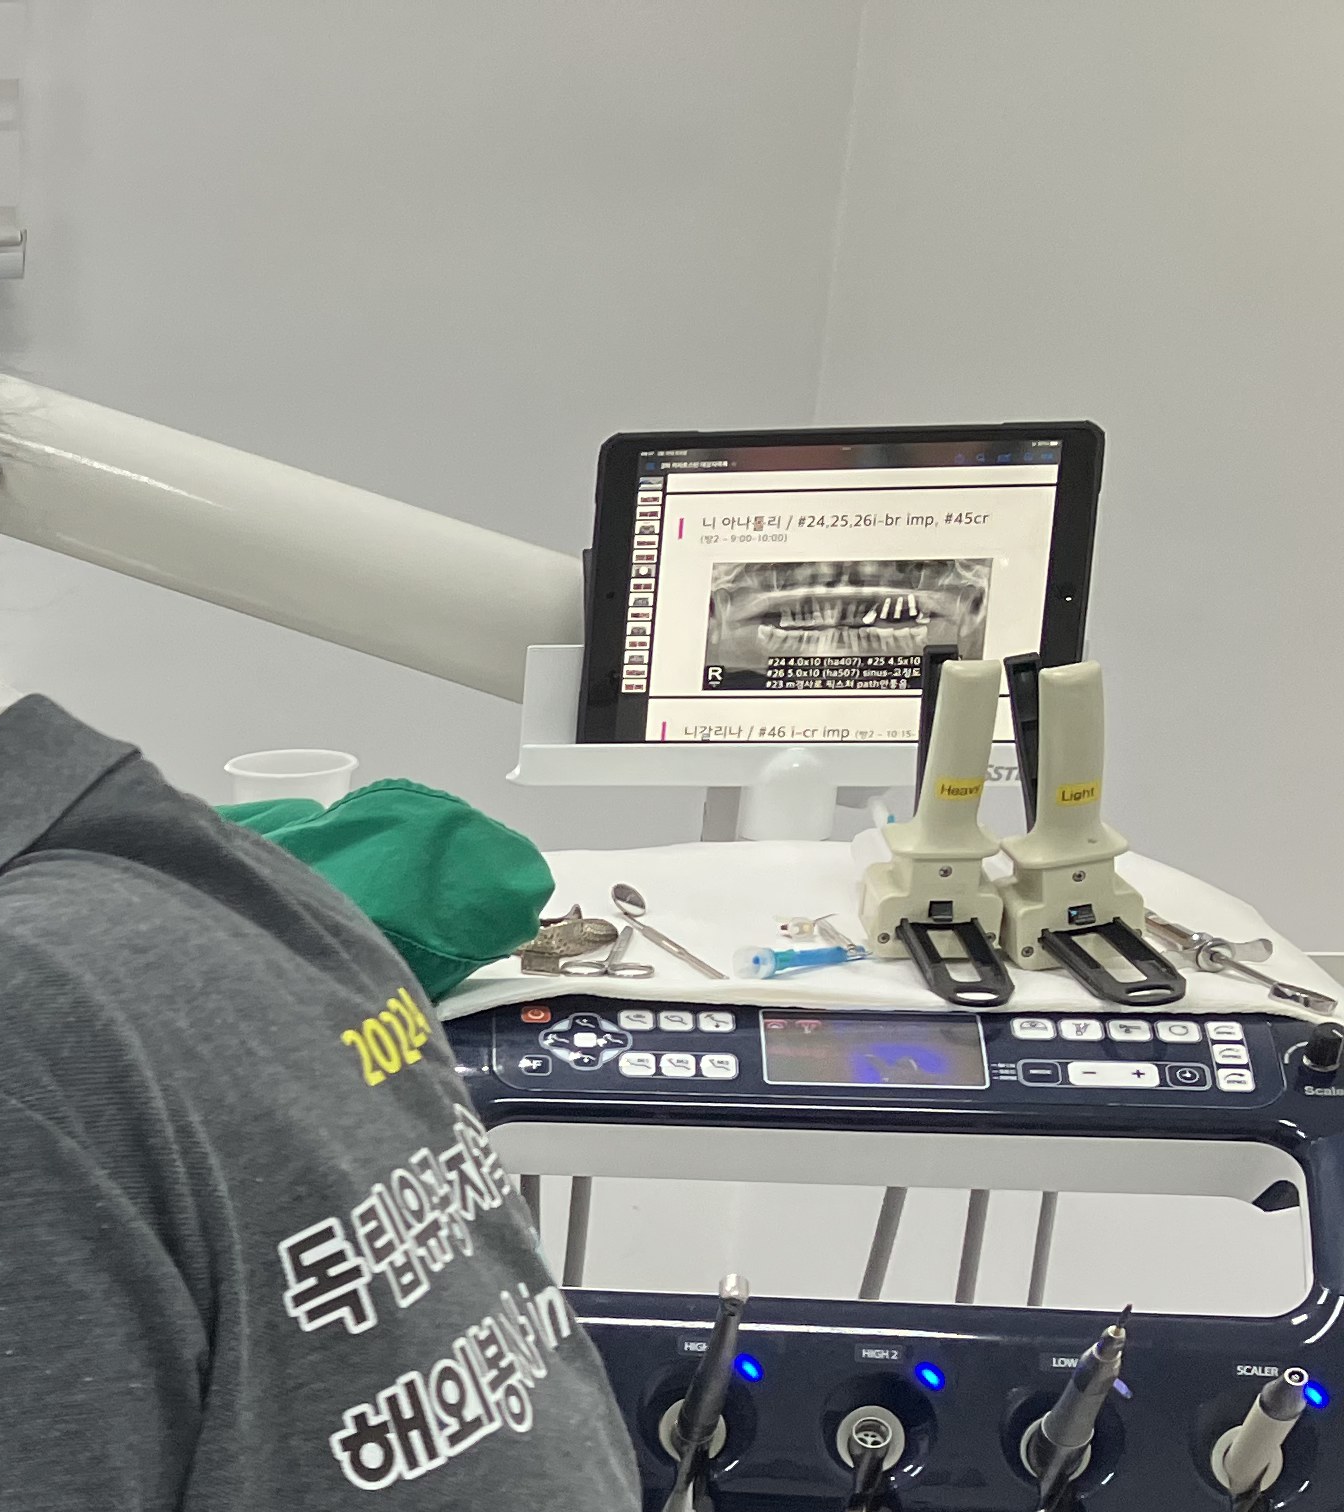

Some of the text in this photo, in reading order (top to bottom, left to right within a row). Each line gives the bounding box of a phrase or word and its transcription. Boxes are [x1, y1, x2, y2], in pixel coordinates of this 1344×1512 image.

[702, 516, 716, 530] 니
[944, 511, 990, 525] #45cr
[708, 667, 723, 681] R
[758, 726, 786, 739] #46
[791, 726, 818, 739] i-cr
[822, 725, 850, 741] imp
[1061, 787, 1095, 802] Light
[862, 1348, 898, 1360] HIGH 2
[1052, 1357, 1078, 1368] LOW
[1236, 1365, 1279, 1377] SCALER
[330, 1289, 548, 1490] 해외봉사
